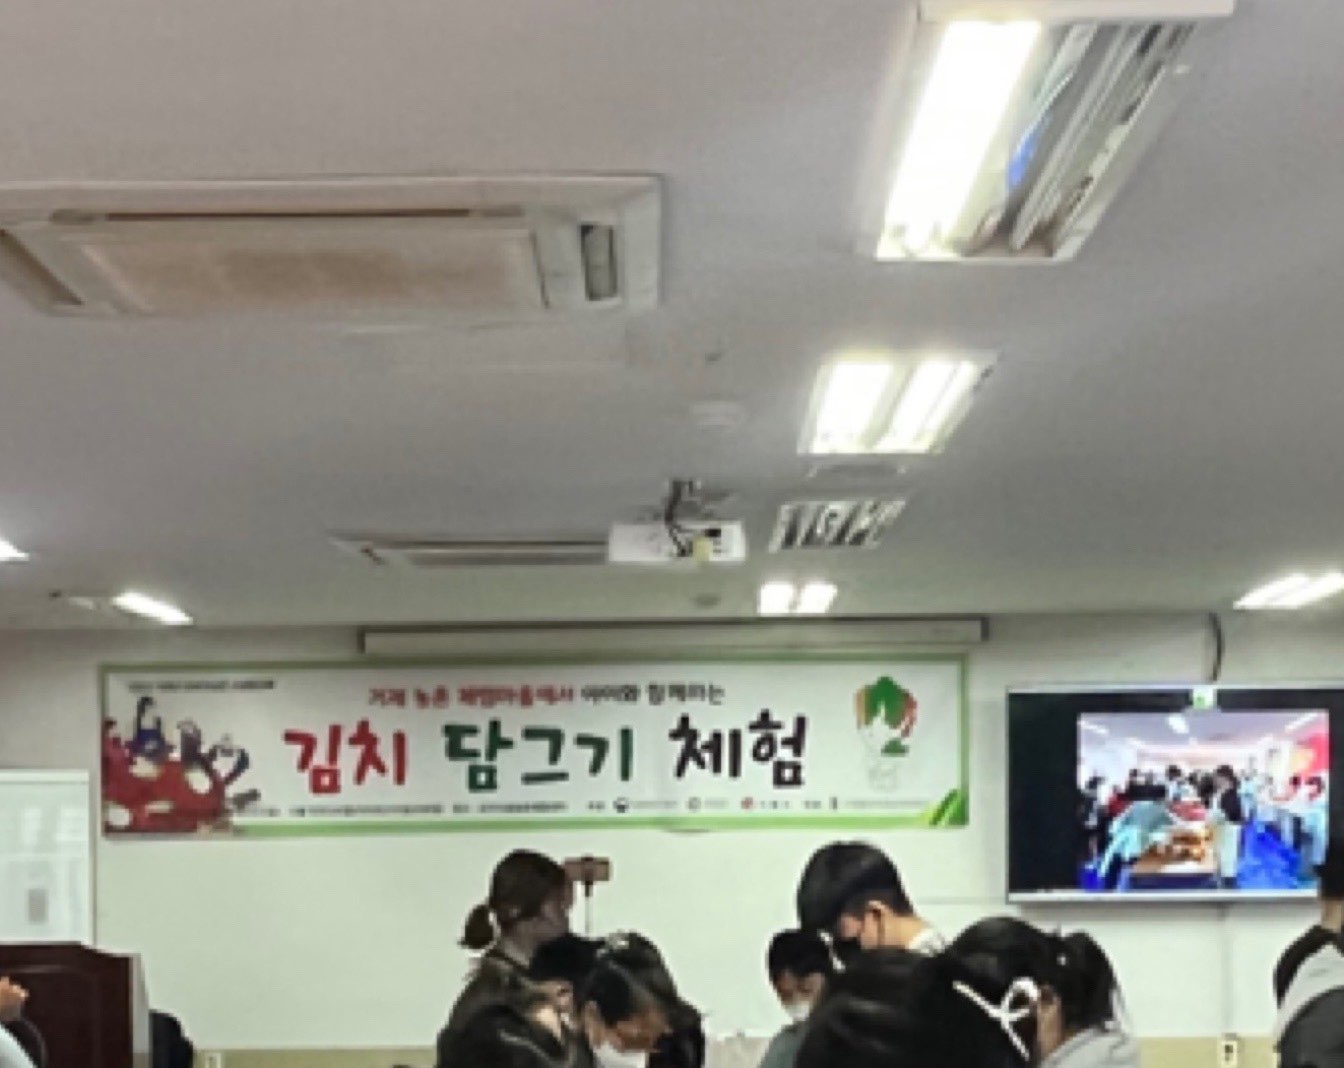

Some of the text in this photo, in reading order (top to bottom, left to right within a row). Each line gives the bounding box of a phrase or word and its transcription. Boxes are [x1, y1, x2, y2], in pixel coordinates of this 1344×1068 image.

[283, 709, 808, 794] 김치 담그기 체험
